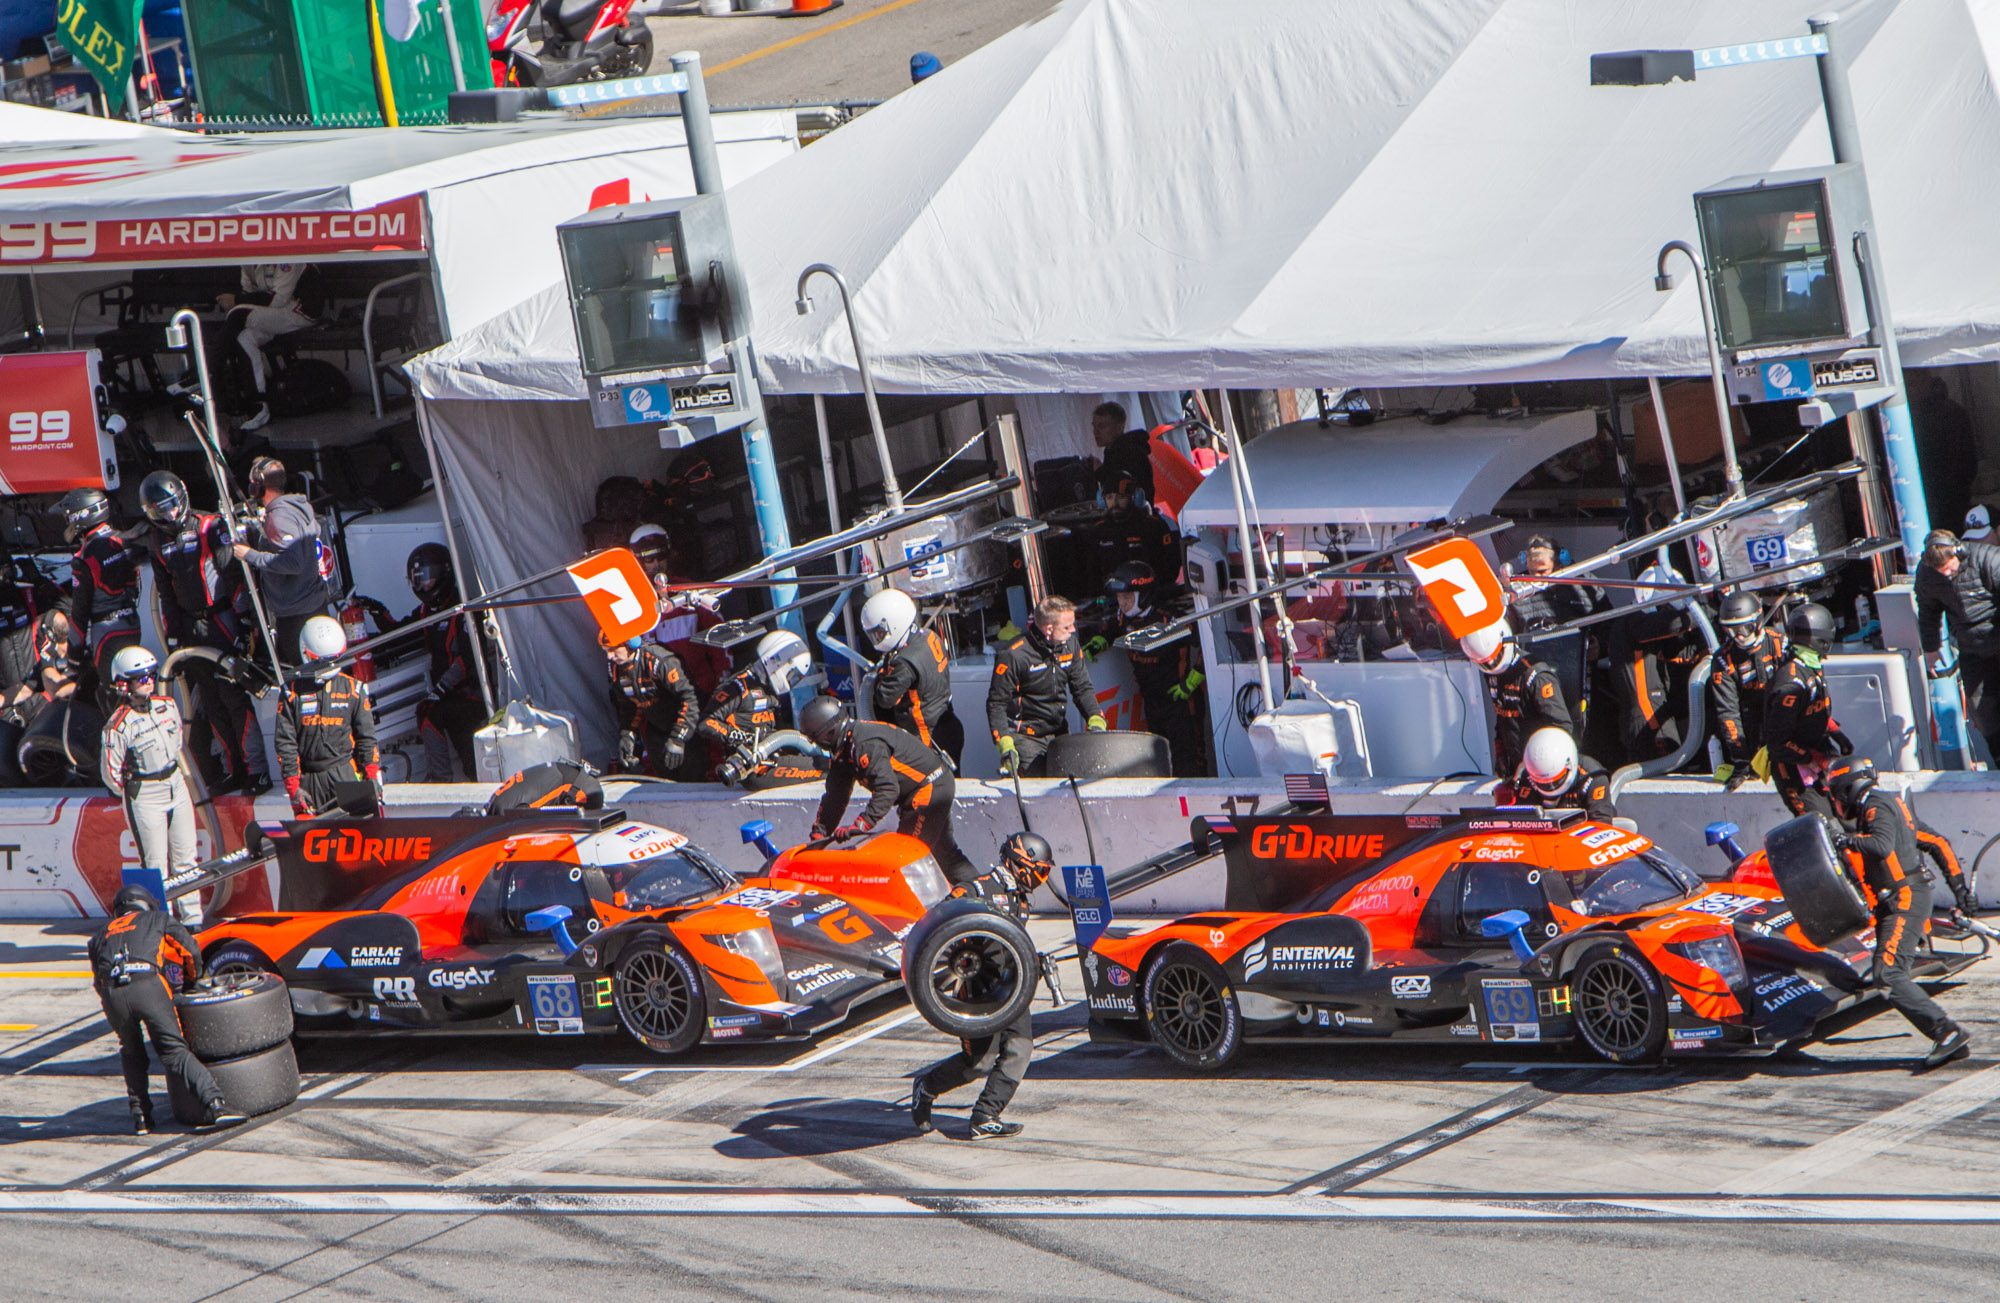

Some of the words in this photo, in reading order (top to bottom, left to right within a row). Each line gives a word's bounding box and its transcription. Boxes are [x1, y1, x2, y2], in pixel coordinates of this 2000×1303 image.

[120, 213, 406, 246] HARDPOINT.COM
[9, 410, 70, 443] 99
[11, 442, 74, 451] HARDPOINT.COM
[1753, 538, 1782, 561] 69
[1469, 821, 1494, 829] LOCAL
[1512, 821, 1553, 829] ROADWAYS
[792, 872, 814, 881] Drive
[814, 874, 834, 882] Fast
[840, 874, 856, 883] Act
[857, 875, 890, 884] Faster
[1078, 911, 1098, 921] CLC
[212, 951, 250, 968] MICHELIN
[351, 946, 403, 958] CARLAC
[1272, 946, 1356, 961] ENTERVAL
[351, 957, 401, 967] MINERALS
[1272, 962, 1330, 972] Analytics
[1334, 960, 1354, 969] LLC
[676, 954, 699, 994] MICHELIN
[595, 977, 613, 1008] 2
[1551, 985, 1572, 1013] 4
[535, 984, 575, 1017] 68
[1089, 993, 1136, 1013] Luding
[1490, 988, 1532, 1022] 69
[1320, 1011, 1329, 1024] P2
[713, 1028, 742, 1037] MOTUL
[1218, 1008, 1235, 1058] MICHELIN
[1682, 1030, 1717, 1038] MICHELIN
[1673, 1040, 1704, 1049] MOTUL
